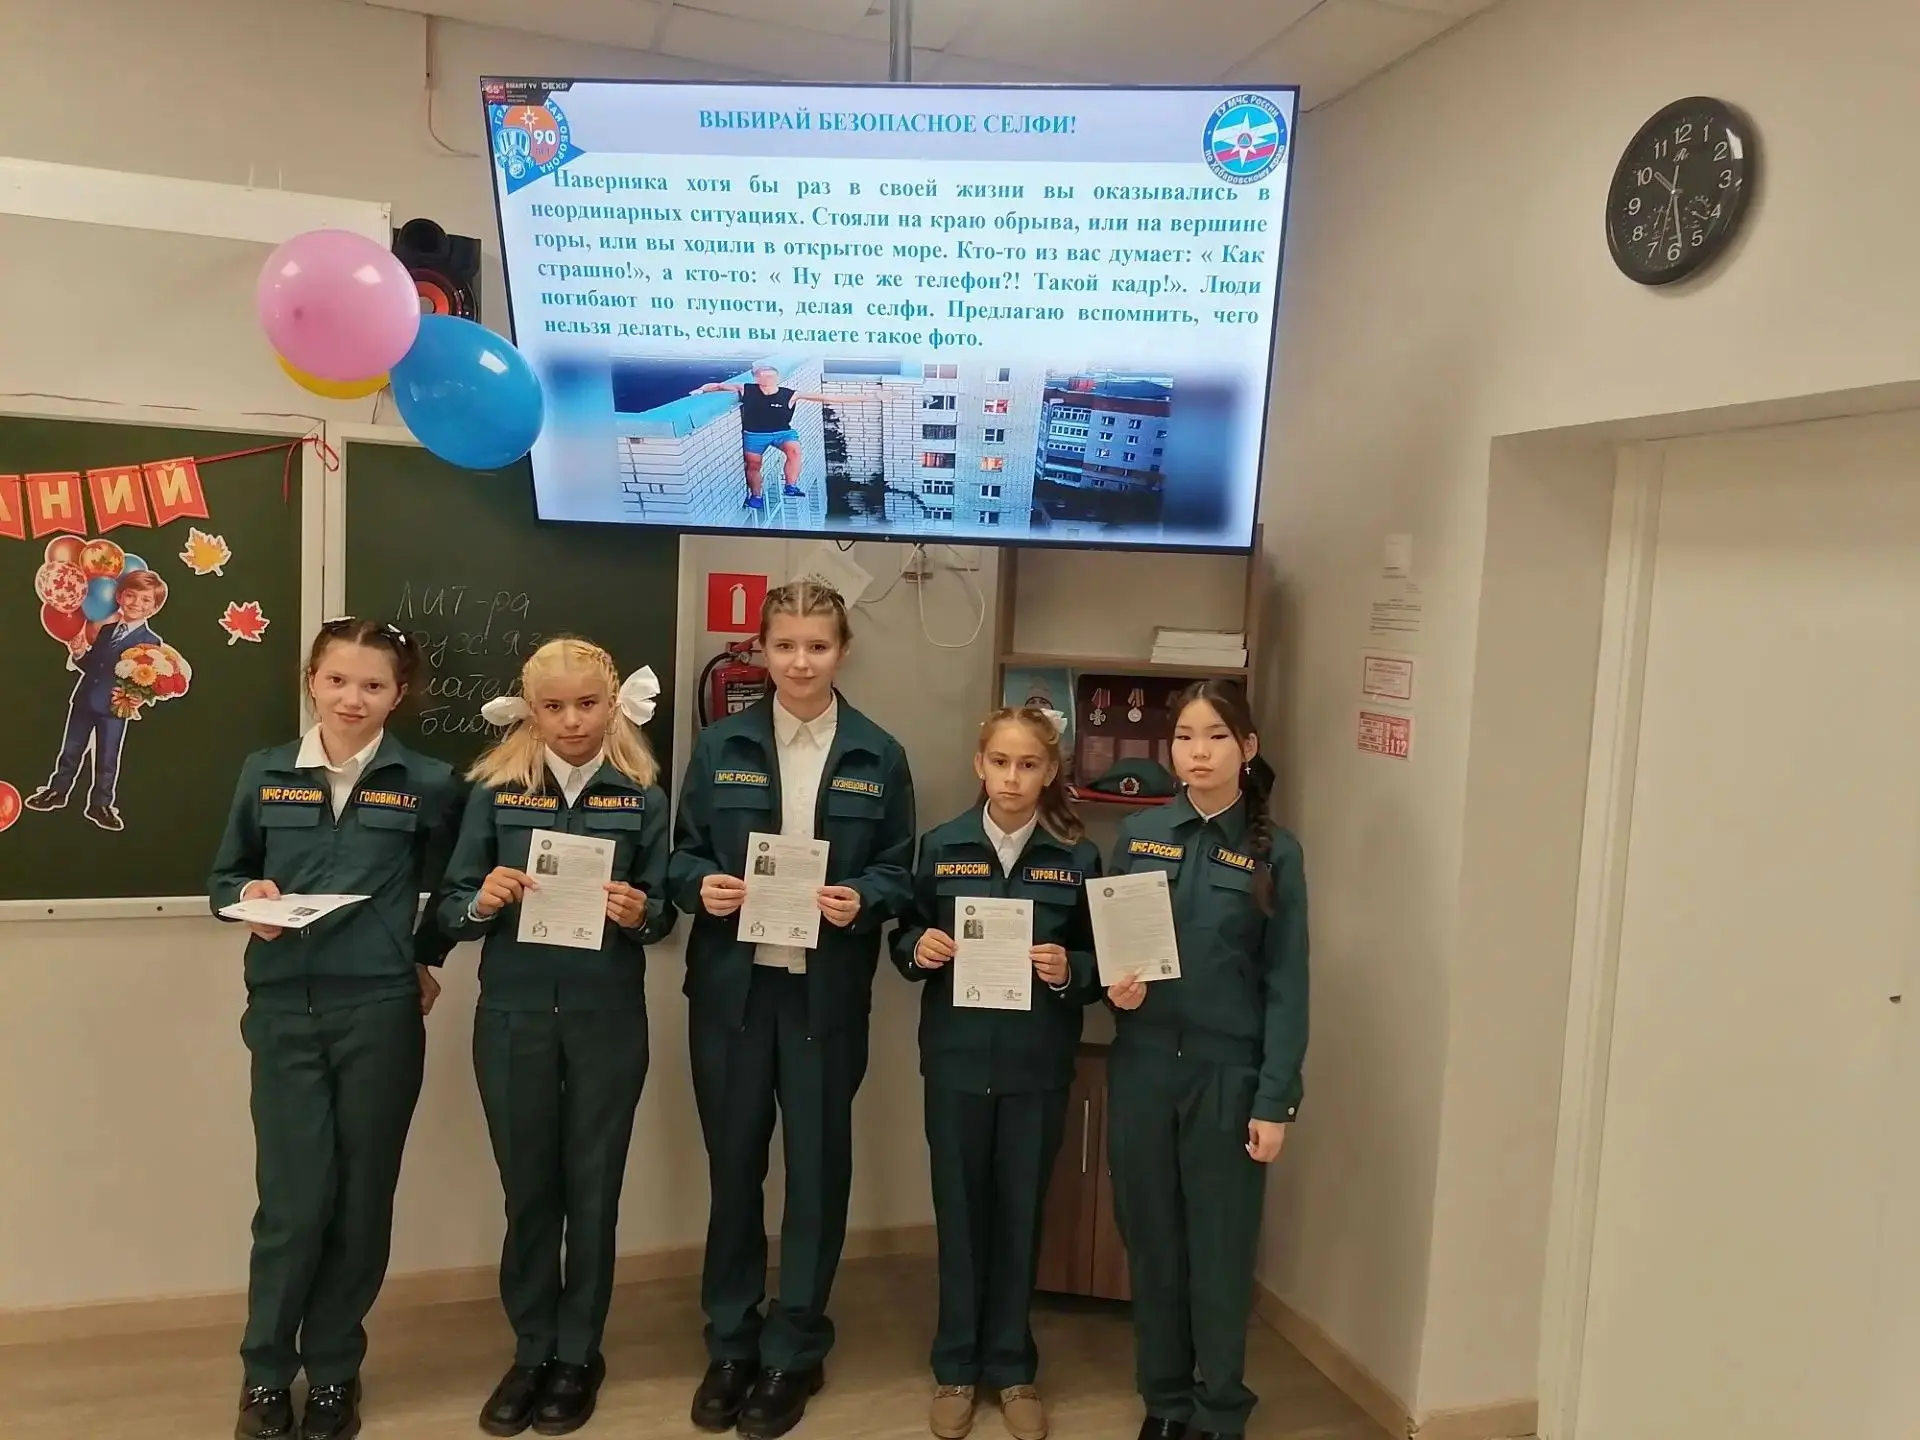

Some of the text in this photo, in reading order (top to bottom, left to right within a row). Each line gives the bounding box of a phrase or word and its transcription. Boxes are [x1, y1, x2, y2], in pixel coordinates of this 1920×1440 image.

[541, 82, 568, 90] DEXP
[1227, 94, 1249, 108] МЧС
[1250, 95, 1279, 118] России
[700, 107, 1075, 133] ВЫБИРАЙ БЕЗОПАСНОЕ СЕЛФИ!
[533, 129, 557, 145] 90
[1675, 123, 1693, 144] 12
[1703, 124, 1709, 142] 1
[540, 126, 568, 173] ОБОРОНА
[1654, 139, 1668, 159] 11
[1713, 141, 1728, 161] 2
[553, 169, 1269, 201] Наверняка хотя бы раз в своей жизни вы оказывались в
[1636, 166, 1653, 187] 10
[1719, 169, 1732, 188] 3
[1628, 197, 1641, 216] 9
[532, 205, 1267, 236] неординарных ситуациях. Стояли на краю обрыва, или на вершине
[1632, 225, 1644, 241] 8
[1691, 229, 1704, 246] 5
[535, 235, 591, 252] горы,
[600, 237, 636, 249] или
[646, 238, 674, 250] вы
[684, 240, 754, 254] ходили
[764, 242, 775, 253] в
[784, 242, 883, 260] открытое
[893, 245, 947, 262] море.
[958, 241, 1026, 259] Кто-то
[1036, 248, 1057, 260] из
[1067, 248, 1100, 261] вас
[1109, 249, 1191, 266] думает:
[1222, 245, 1264, 263] Как
[1648, 241, 1659, 258] 7
[1667, 242, 1681, 261] 6
[538, 262, 650, 282] страшно!»,
[663, 268, 672, 280] а
[686, 269, 756, 283] кто-то:
[792, 267, 820, 289] Ну
[835, 274, 863, 288] где
[876, 274, 902, 286] же
[915, 272, 1019, 293] телефон?!
[1034, 273, 1098, 291] Такой
[1112, 275, 1186, 297] кадр!».
[1200, 276, 1260, 296] Люди
[542, 290, 1258, 325] погибают по глупости, делая селфи. Предлагаю вспомнить, чего
[545, 321, 982, 349] нельзя делать, если вы делаете такое фото.
[718, 772, 767, 784] МЧС РОССИИ
[262, 788, 323, 801] МЧС РОССИИ
[359, 790, 401, 806] ГОЛОВИНА
[497, 793, 557, 809] МЧС РОССИИ
[1131, 841, 1183, 858] МЧС РОССИИ
[936, 863, 989, 876] МЧС РОССИИ
[1030, 869, 1058, 880] ЧУРОВА
